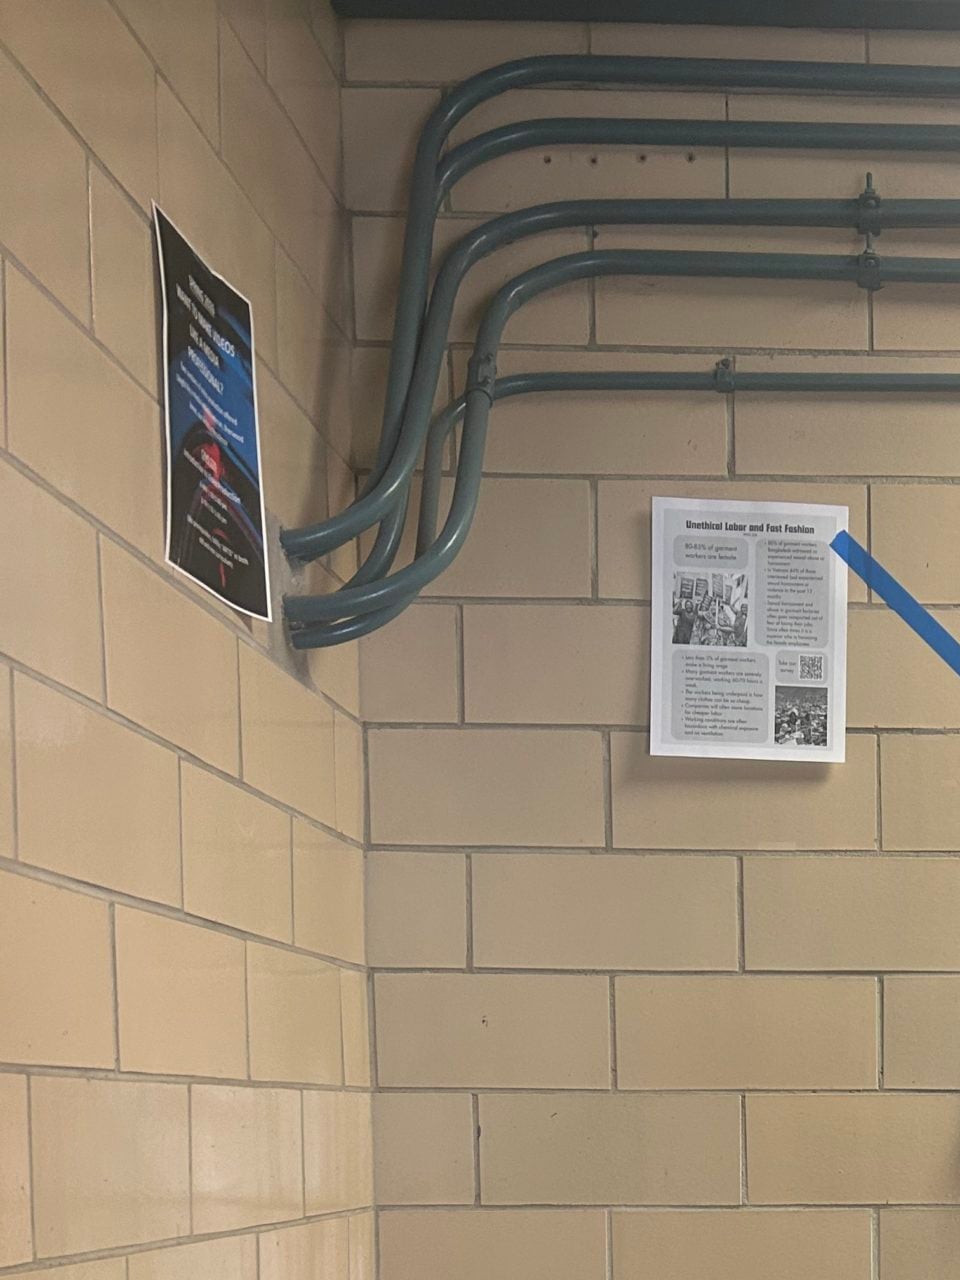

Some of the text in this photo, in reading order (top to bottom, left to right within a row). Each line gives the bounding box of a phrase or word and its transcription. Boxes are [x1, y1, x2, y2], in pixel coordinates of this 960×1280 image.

[212, 328, 235, 357] VIDEOS
[686, 520, 814, 534] Unethical Labor and Fast Fashion
